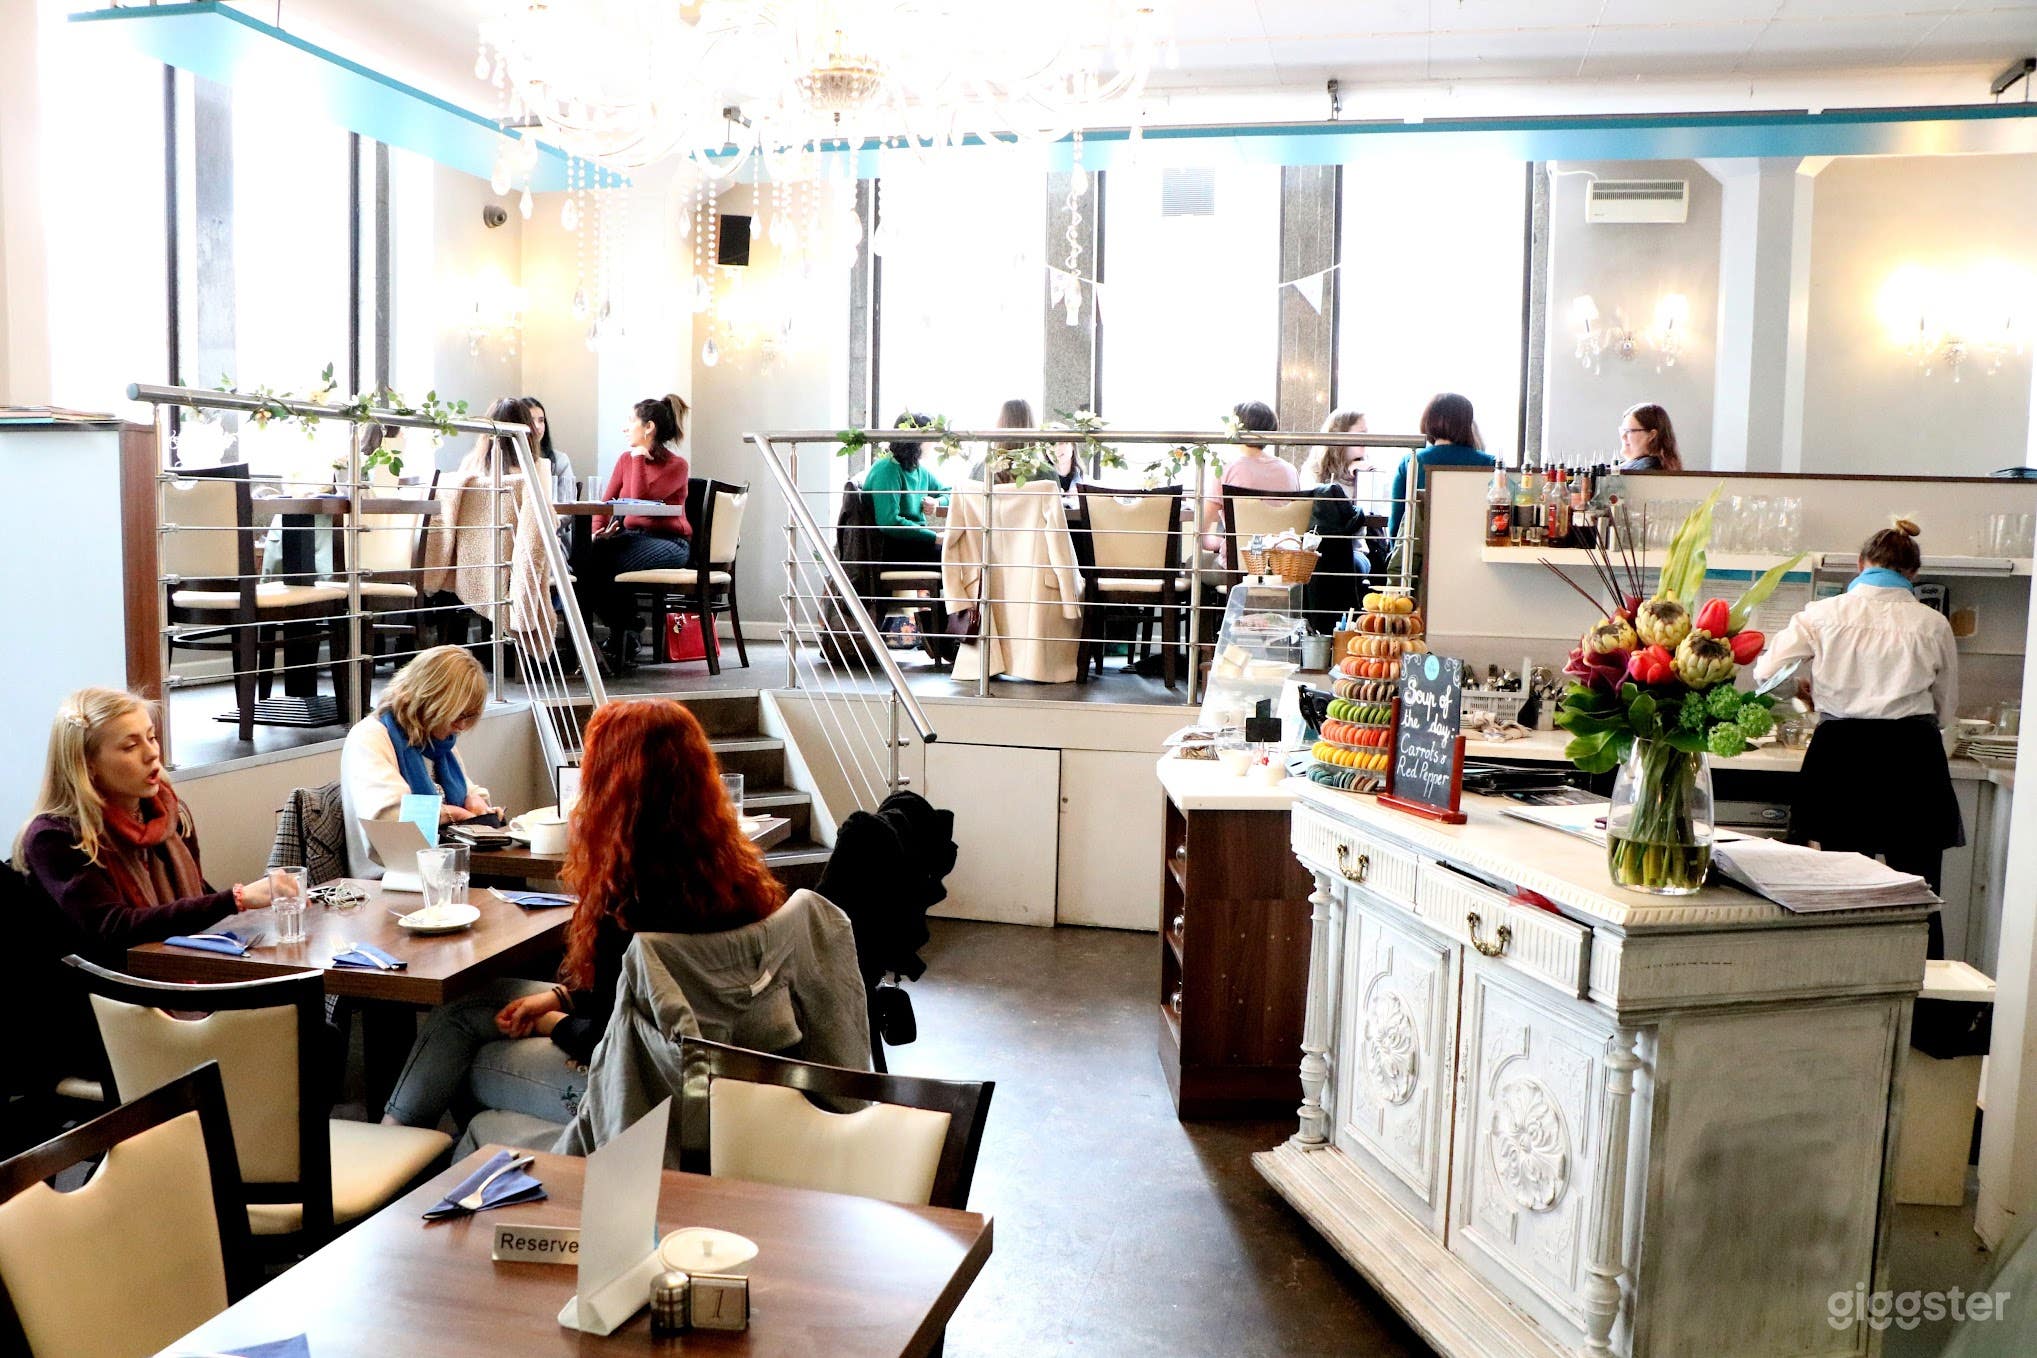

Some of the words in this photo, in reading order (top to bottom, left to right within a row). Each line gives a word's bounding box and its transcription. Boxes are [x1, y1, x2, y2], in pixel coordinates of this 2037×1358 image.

[1404, 676, 1437, 721] Soup
[1439, 684, 1453, 720] of
[1400, 732, 1439, 764] Carrots
[1401, 708, 1420, 729] the
[1427, 712, 1456, 749] day:
[1396, 755, 1420, 779] Red
[1419, 760, 1450, 799] Pepper
[500, 1232, 579, 1254] Reserve
